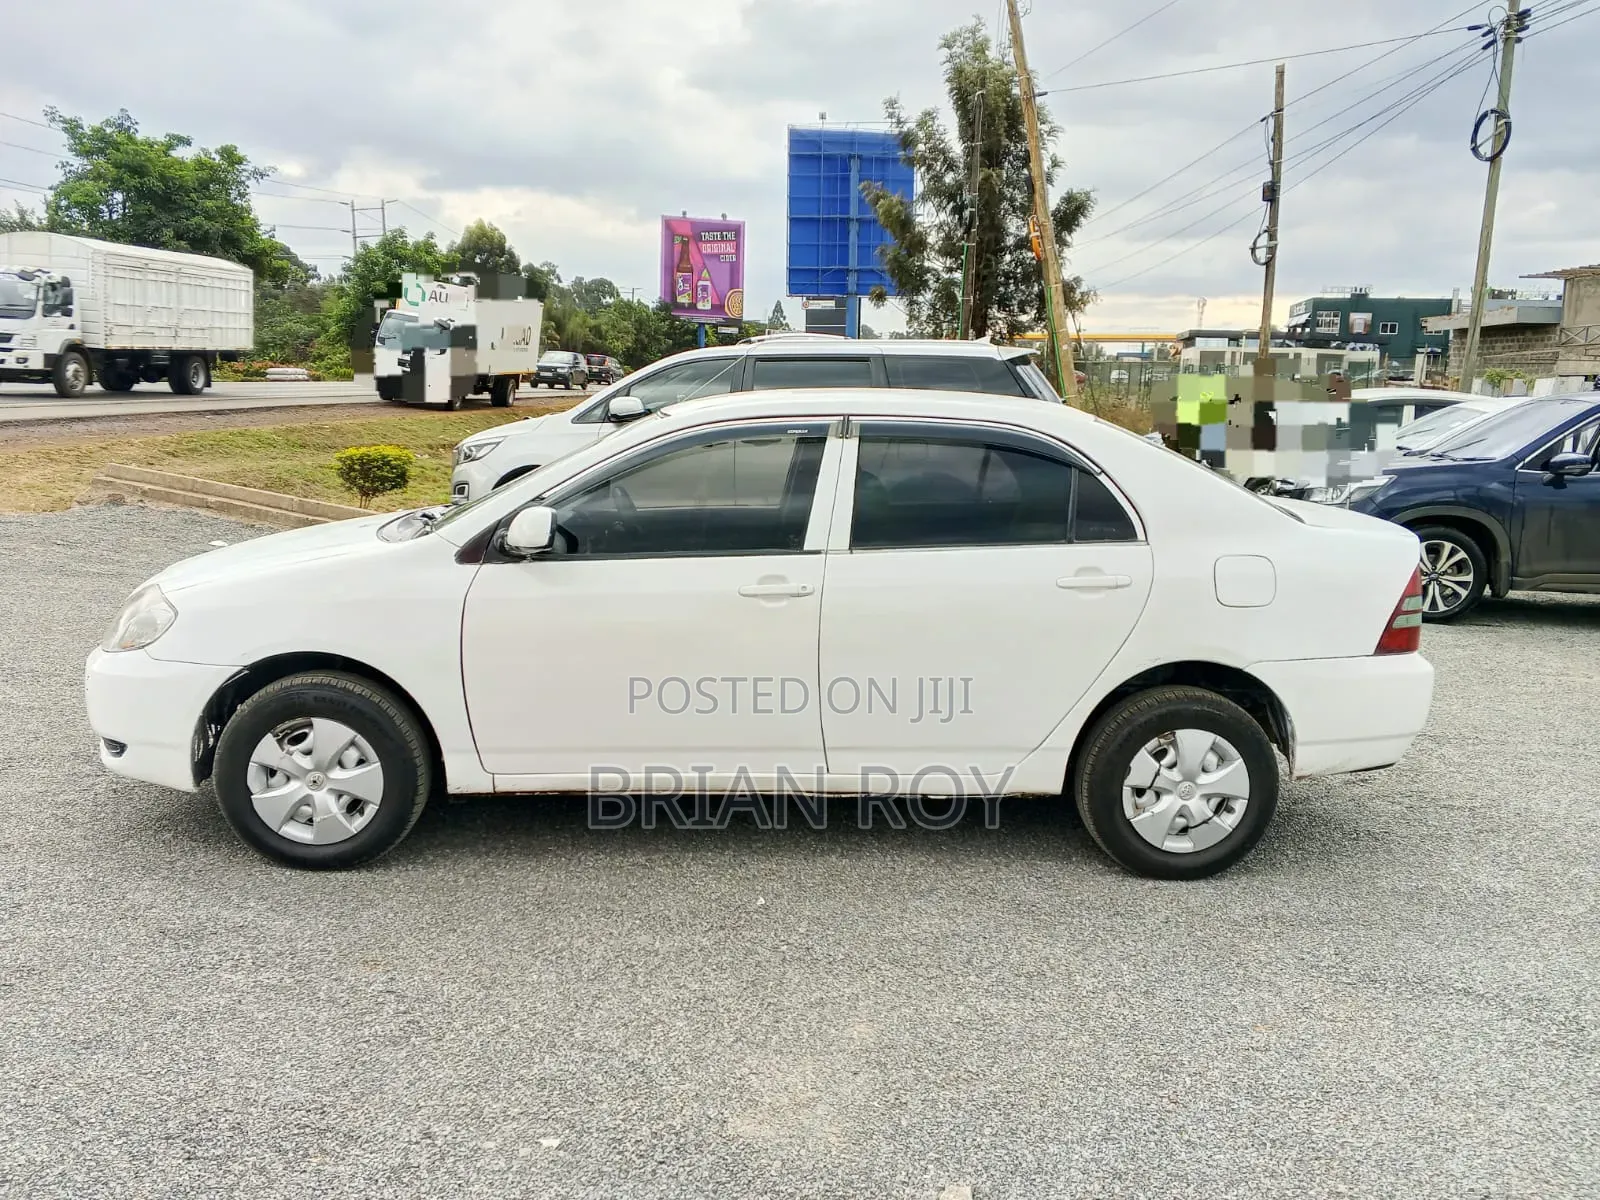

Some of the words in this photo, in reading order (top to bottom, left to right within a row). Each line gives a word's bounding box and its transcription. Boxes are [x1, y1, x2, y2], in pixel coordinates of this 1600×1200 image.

[701, 231, 721, 241] TASTE
[723, 231, 736, 240] THE
[702, 243, 736, 253] ORIGINAL
[720, 254, 736, 262] CIDER
